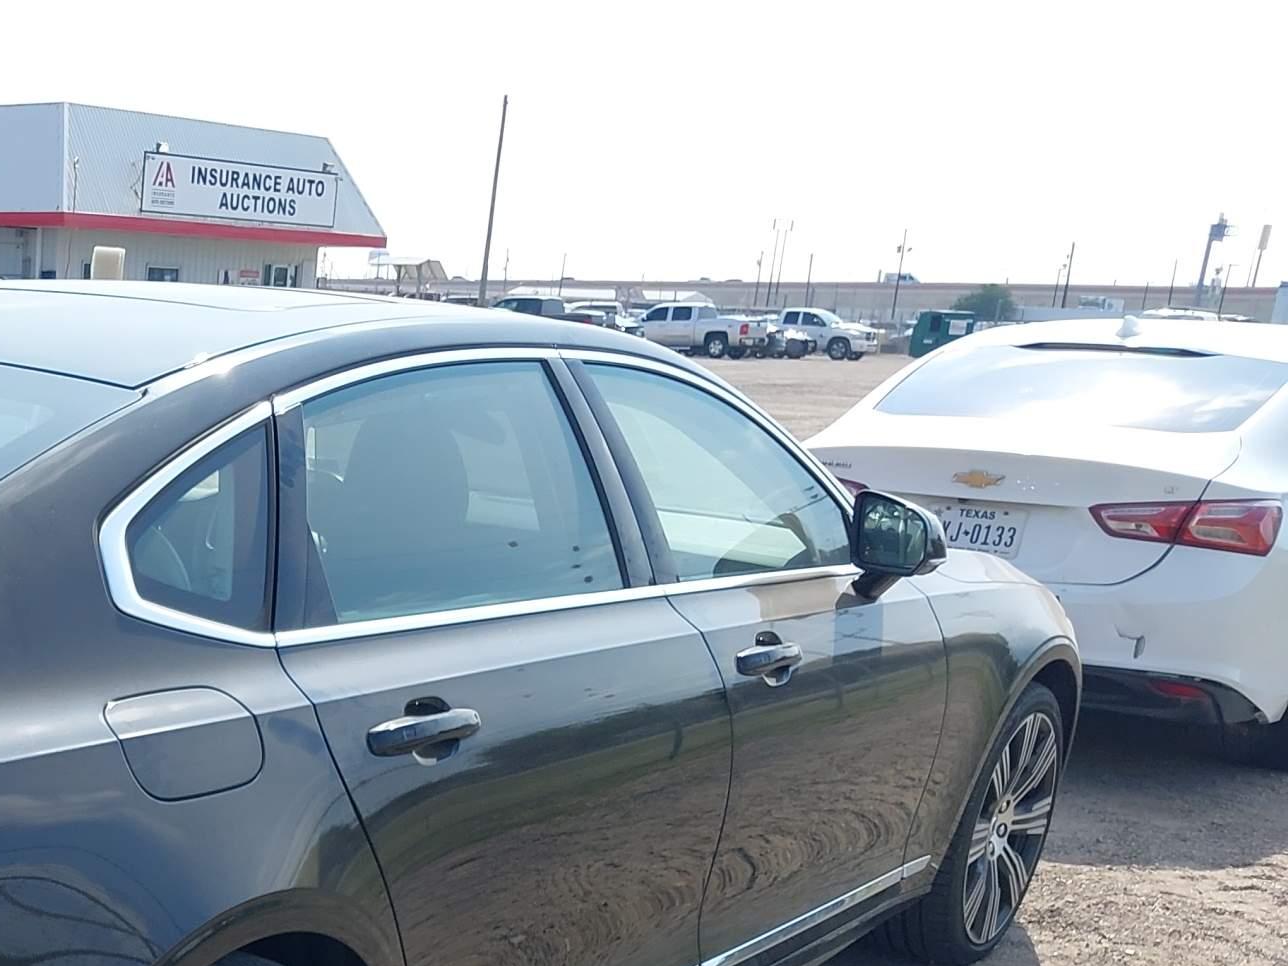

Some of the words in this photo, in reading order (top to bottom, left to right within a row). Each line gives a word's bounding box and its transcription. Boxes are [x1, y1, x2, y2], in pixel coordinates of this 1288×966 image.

[191, 165, 282, 193] INSURANCE
[286, 177, 326, 197] AUTO
[219, 191, 297, 217] AUCTIONS
[959, 508, 996, 521] TEXAS
